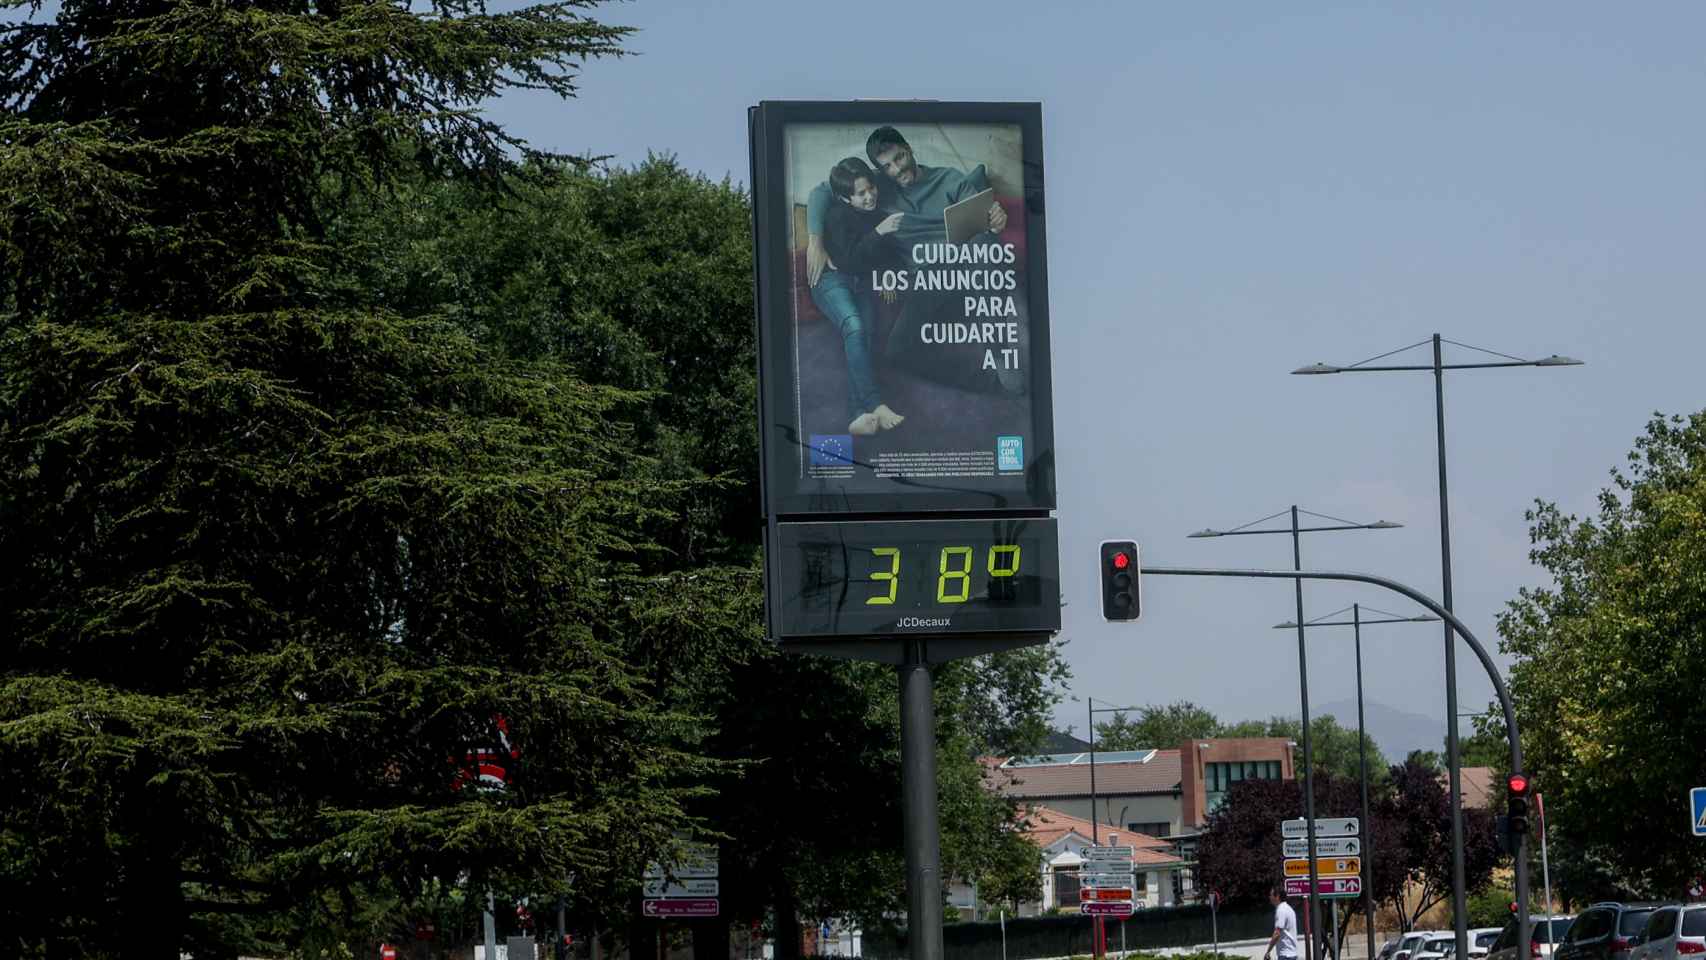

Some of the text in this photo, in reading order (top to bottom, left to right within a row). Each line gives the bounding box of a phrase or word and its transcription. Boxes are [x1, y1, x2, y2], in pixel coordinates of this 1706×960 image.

[912, 242, 1016, 264] CUIDAMOS
[872, 269, 1017, 292] LOS ANUNCIOS
[964, 295, 1018, 317] PARA
[920, 322, 1019, 344] CUIDARTE
[982, 348, 1019, 370] A TI
[1001, 439, 1019, 448] AUTO
[896, 616, 951, 629] JCDecaux
